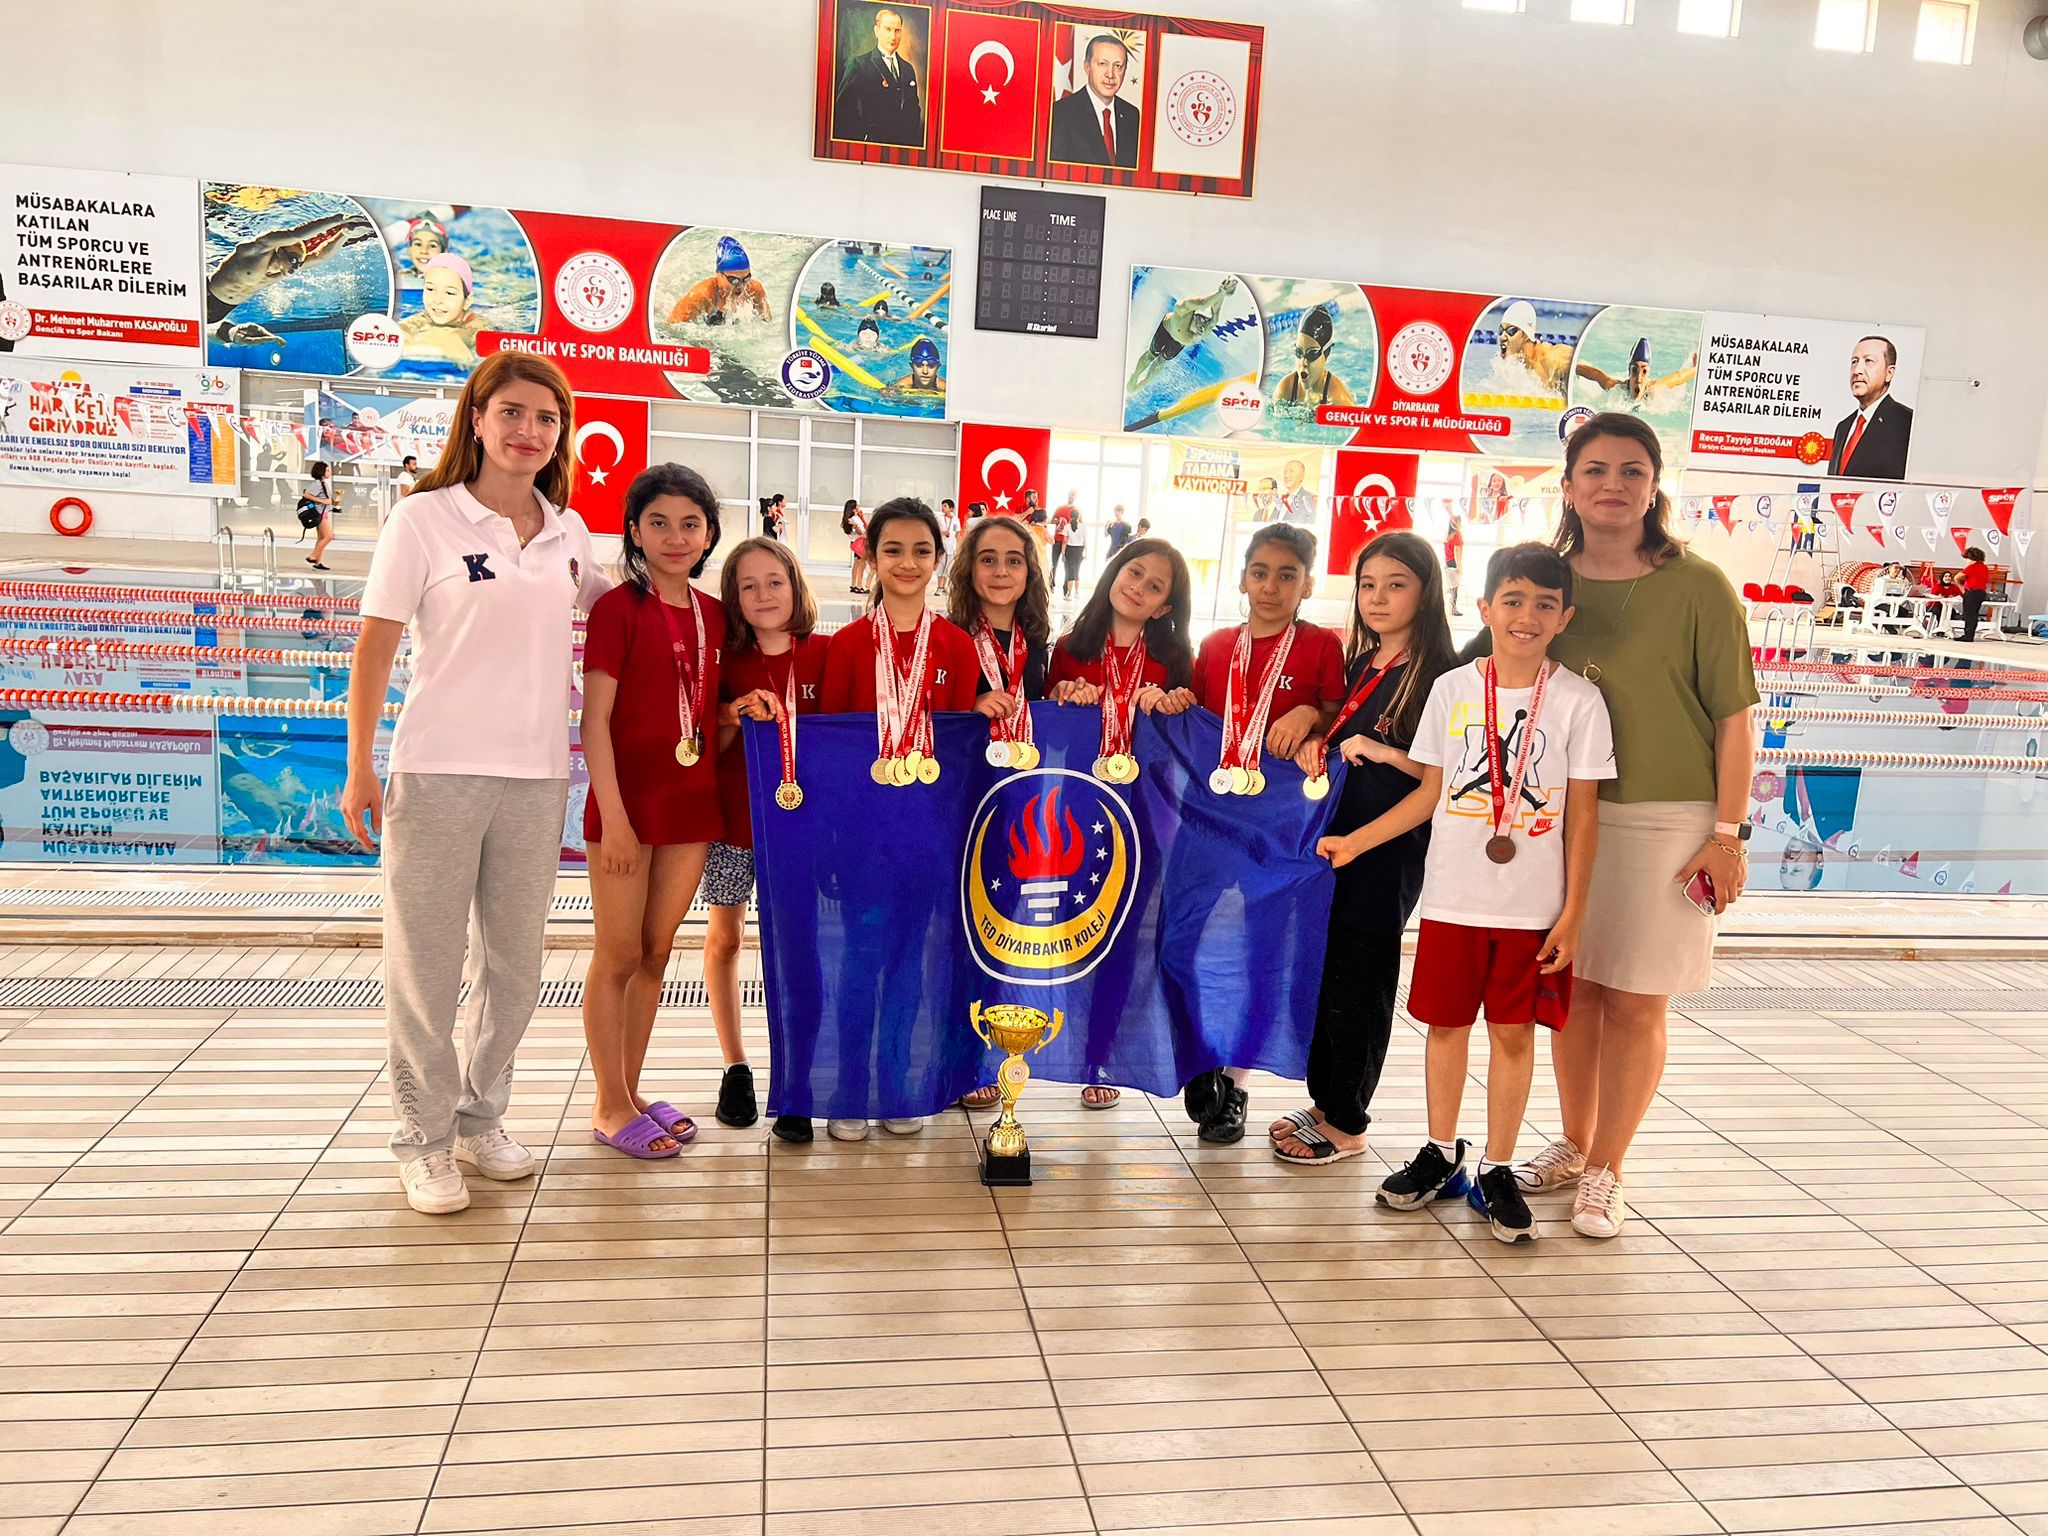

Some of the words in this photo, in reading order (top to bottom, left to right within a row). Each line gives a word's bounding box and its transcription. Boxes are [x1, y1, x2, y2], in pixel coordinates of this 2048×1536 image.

[16, 192, 155, 218] MÜSABAKALARA
[16, 214, 89, 232] KATILAN
[983, 209, 1001, 220] PLACE
[1003, 210, 1017, 221] LINE
[1050, 214, 1076, 226] TIME
[17, 231, 52, 248] TÜM
[57, 237, 123, 253] SPORCU
[129, 242, 149, 255] VE
[17, 254, 152, 275] ANTRENÖRLERE
[19, 272, 113, 291] BAŞARILAR
[118, 277, 186, 297] DİLERİM
[35, 313, 48, 323] Dr.
[50, 314, 86, 326] Mehmet
[87, 316, 132, 329] Muharrem
[134, 319, 188, 333] KASAPOĞLU
[36, 325, 63, 335] Gençlik
[77, 328, 95, 336] Spor
[353, 331, 400, 343] SPOR
[1711, 334, 1809, 354] MÜSABAKALARA
[499, 337, 557, 356] GENÇLİK
[560, 342, 576, 357] VE
[580, 344, 614, 360] SPOR
[619, 348, 689, 367] BAKANLIĞI
[1709, 353, 1761, 366] KATILAN
[1707, 366, 1732, 381] TÜM
[1735, 371, 1783, 385] SPORCU
[1785, 374, 1800, 386] VE
[1705, 385, 1800, 402] ANTRENÖRLERE
[1392, 399, 1440, 413] DİYARBAKIR
[1703, 401, 1770, 416] BAŞARILAR
[1773, 403, 1821, 419] DİLERİM
[1325, 411, 1371, 427] GENÇLİK
[1374, 414, 1387, 425] VE
[1390, 416, 1417, 427] SPOR
[1420, 414, 1430, 428] İL
[1432, 417, 1502, 432] MÜDÜRLÜĞÜ
[20, 436, 30, 445] VE
[70, 440, 91, 448] SPOR
[92, 441, 130, 451] OKULLARI
[1699, 433, 1724, 444] Recep
[1726, 435, 1751, 446] Tayyip
[1754, 435, 1793, 447] ERDOĞAN
[1188, 448, 1233, 463] SPORU
[1185, 463, 1235, 478] TABANA
[1176, 476, 1245, 494] YAYIYORUZ
[462, 553, 496, 582] K
[935, 669, 947, 685] K
[1279, 675, 1294, 690] K
[802, 684, 816, 699] K
[1534, 819, 1552, 829] NIKE
[981, 914, 996, 940] TED
[995, 934, 1073, 956] DİYARBAKIR
